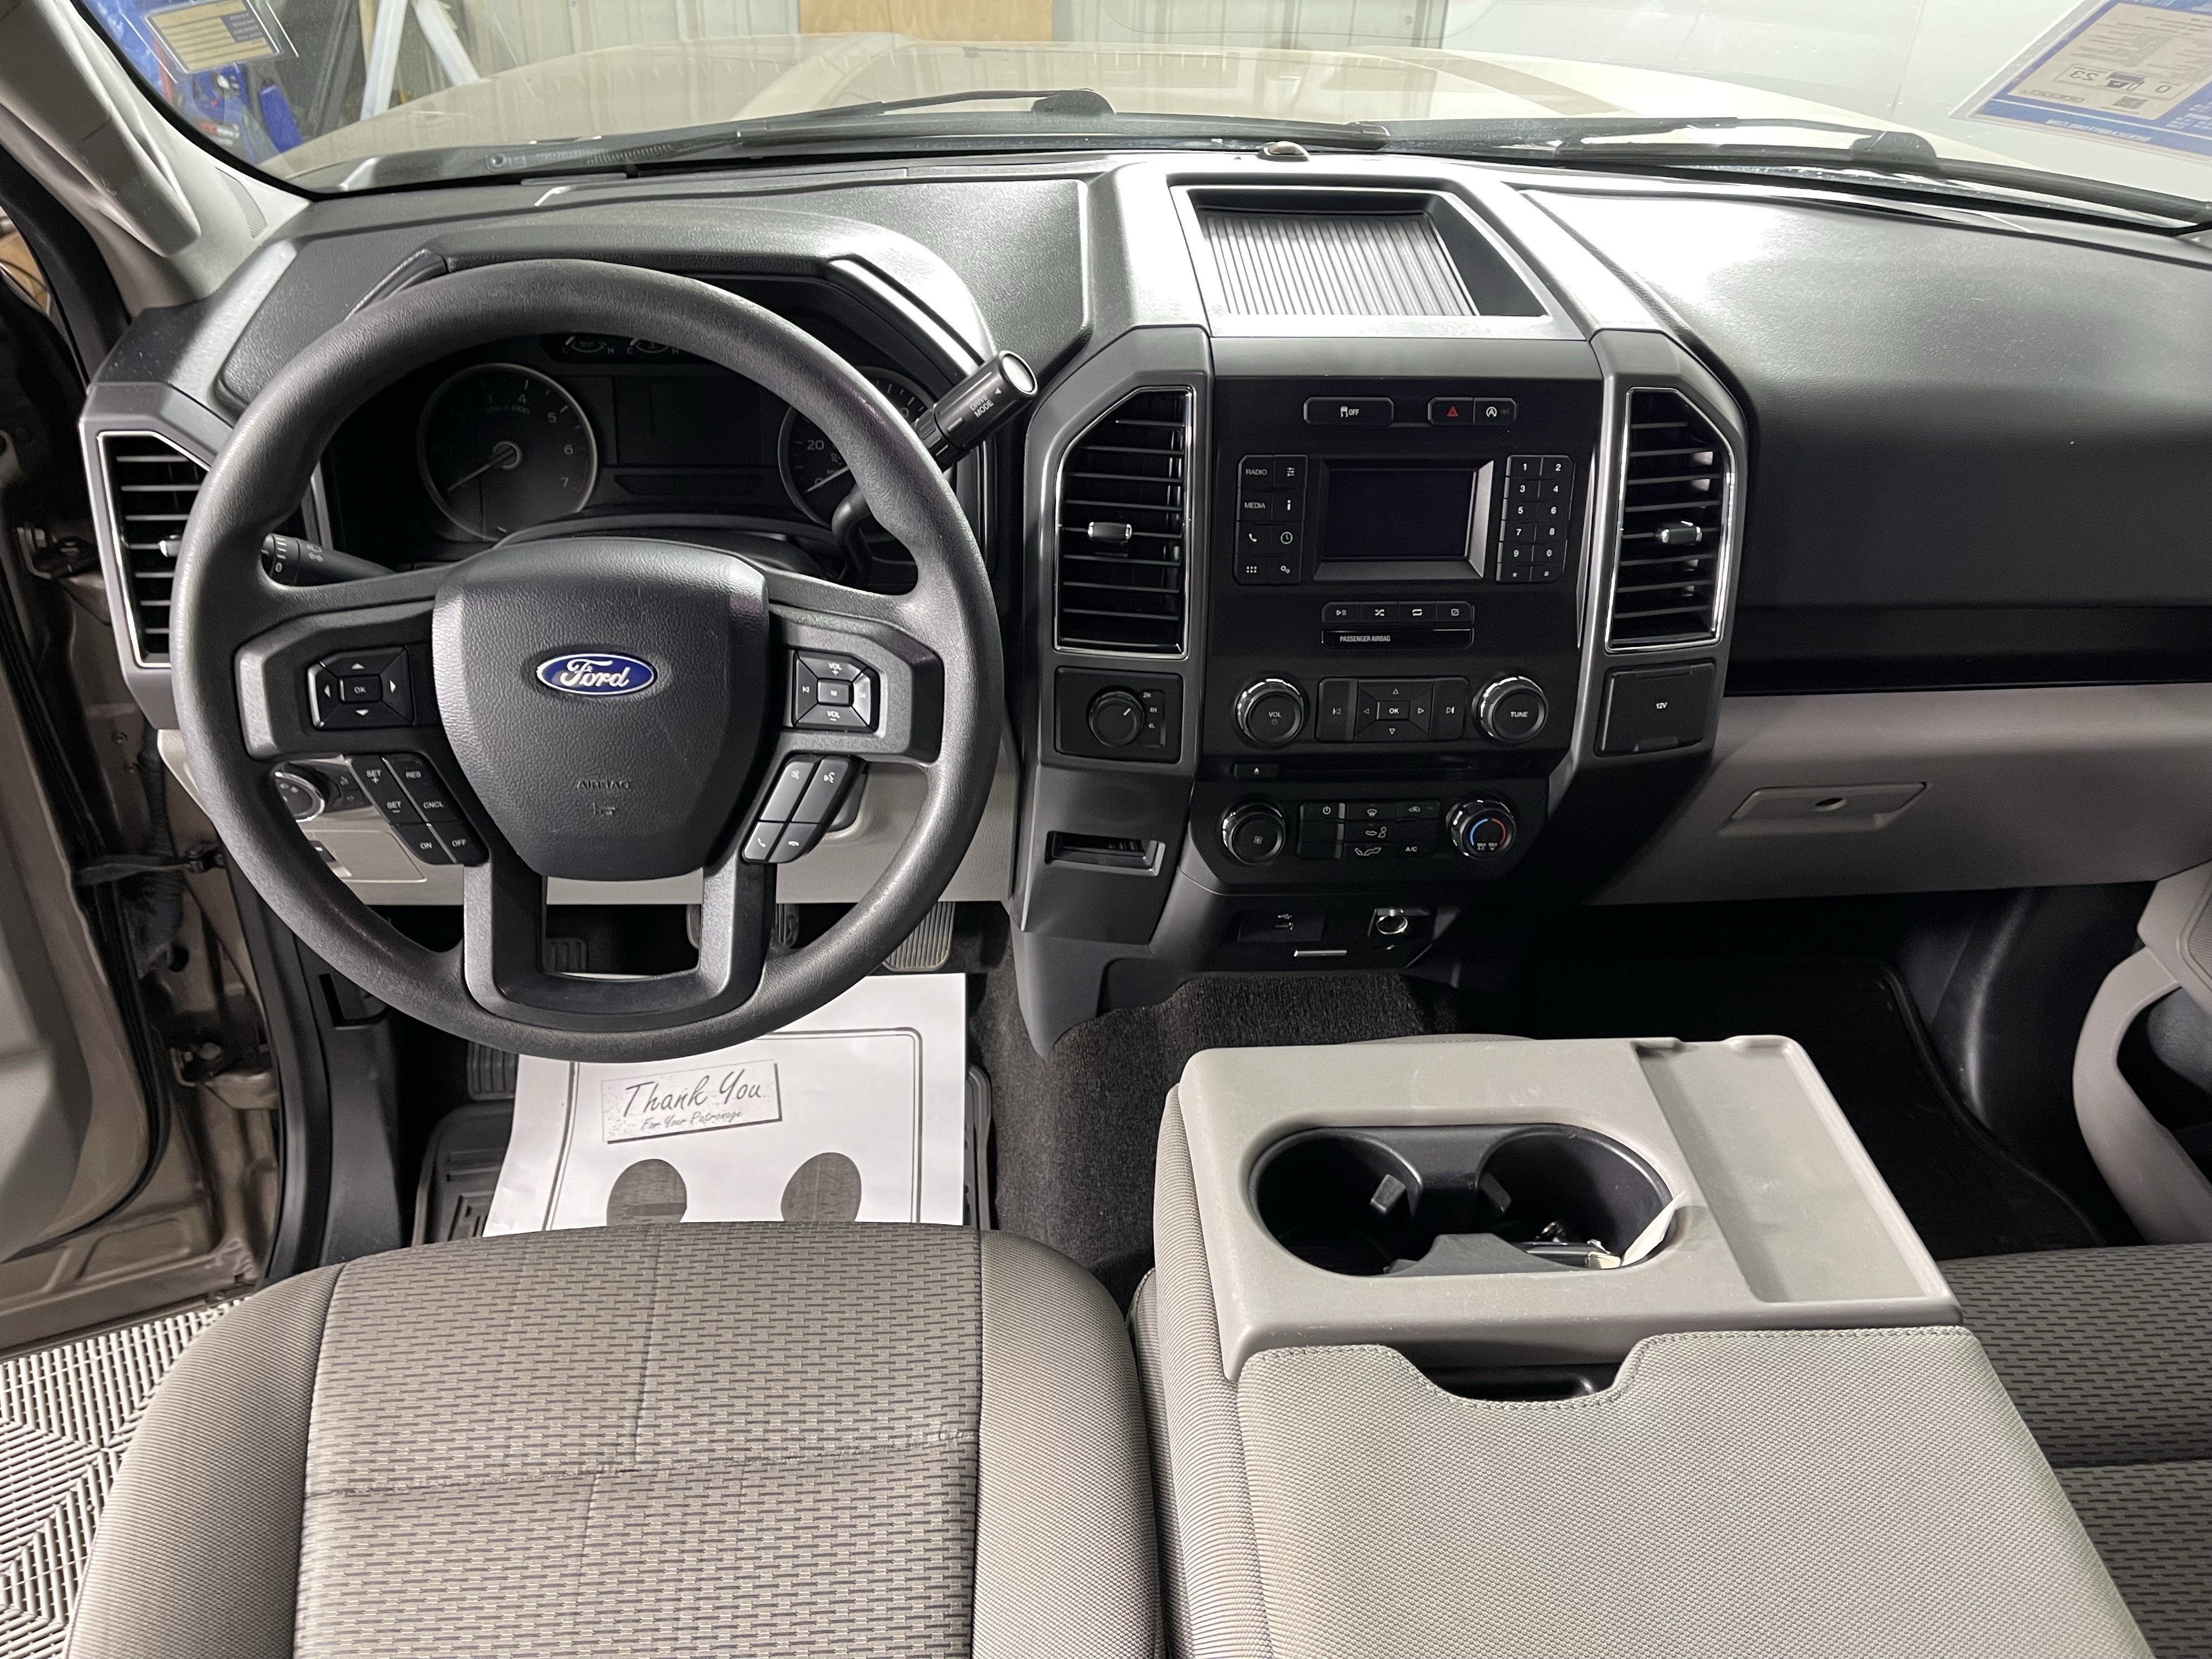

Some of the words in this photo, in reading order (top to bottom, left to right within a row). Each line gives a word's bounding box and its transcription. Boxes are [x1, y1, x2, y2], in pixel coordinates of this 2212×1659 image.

[518, 393, 526, 404] 4
[969, 394, 988, 411] DRIVE
[974, 399, 994, 417] MODE
[548, 411, 557, 424] 5
[564, 444, 573, 455] 6
[807, 439, 825, 450] 20
[1555, 463, 1562, 471] 2
[560, 476, 568, 488] 7
[1520, 484, 1526, 493] 3
[1517, 506, 1523, 515] 5
[1550, 506, 1556, 515] 6
[828, 662, 842, 670] VOL
[560, 658, 631, 687] Ford
[827, 710, 840, 719] VOL
[366, 769, 382, 778] SET
[387, 801, 402, 809] SET
[423, 801, 445, 809] CNCL
[452, 838, 467, 847] OFF
[623, 1075, 710, 1118] Thank
[719, 1068, 764, 1105] You
[640, 1117, 660, 1131] For
[664, 1114, 686, 1128] Your
[690, 1111, 742, 1125] Patronage
